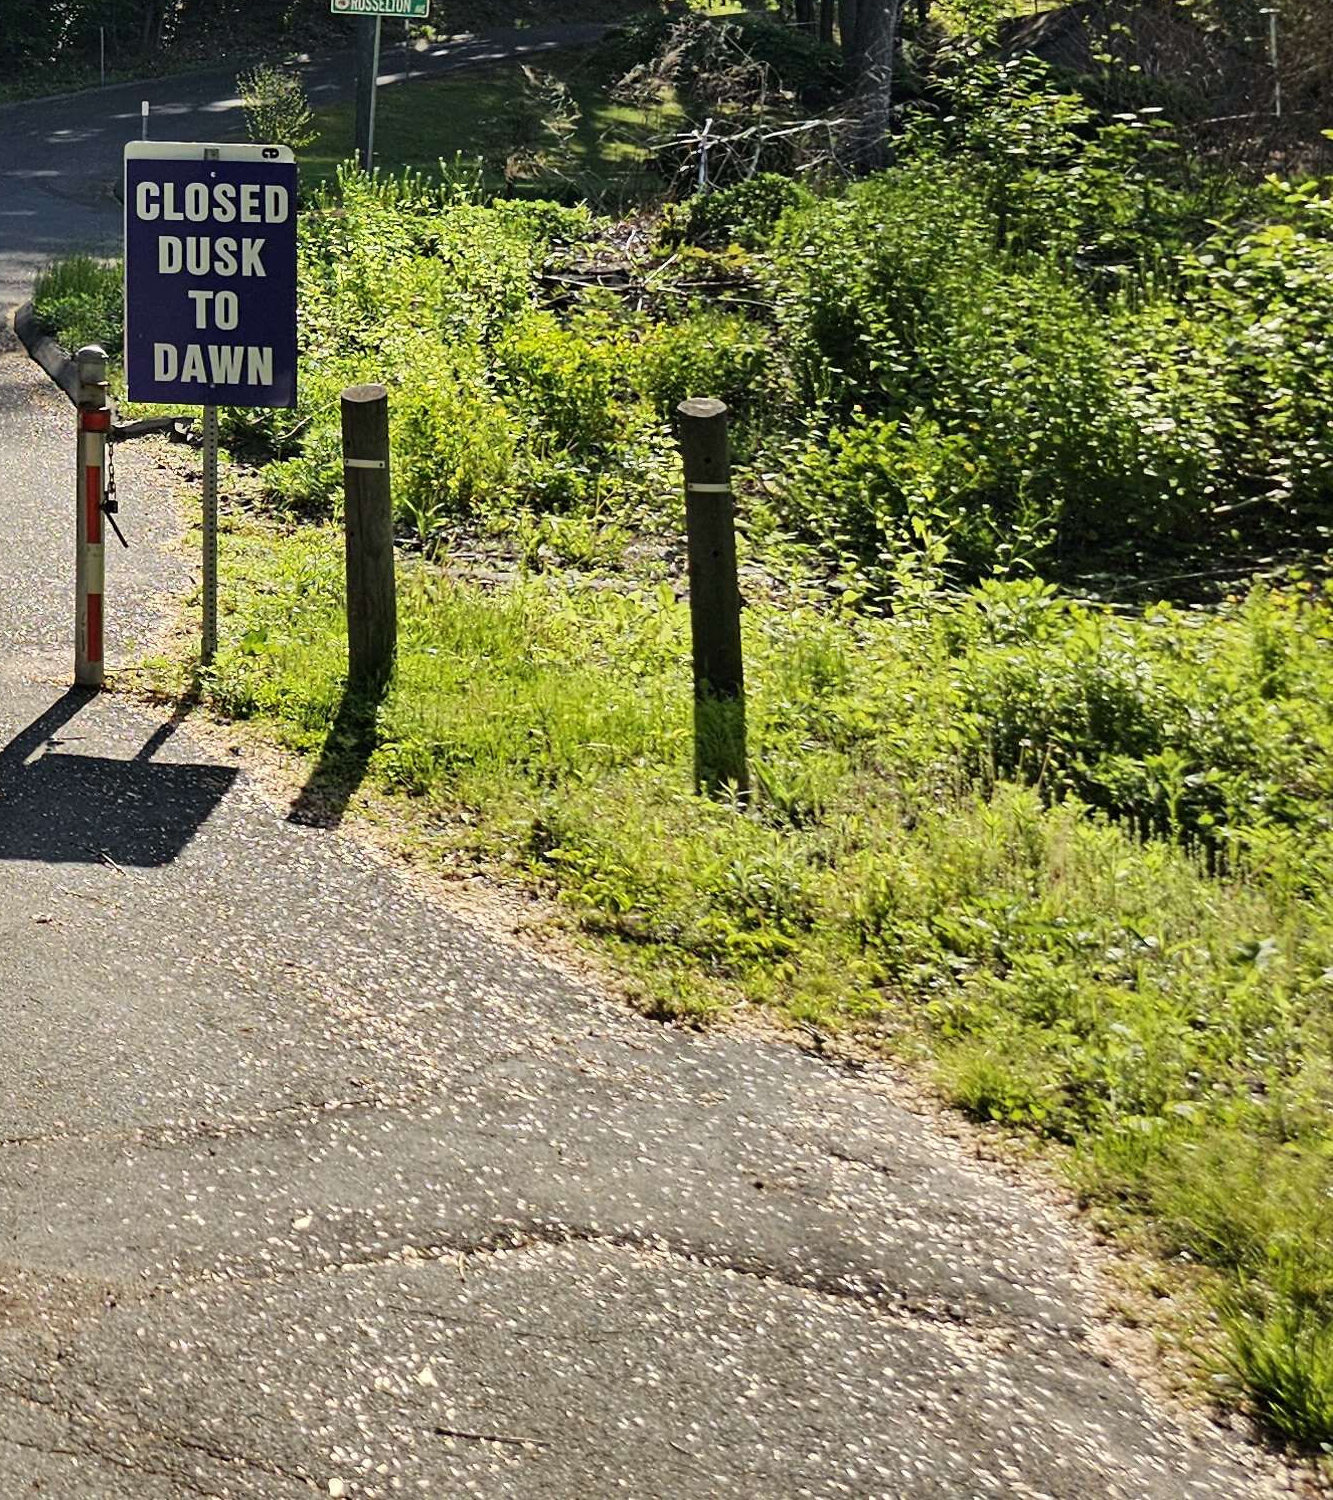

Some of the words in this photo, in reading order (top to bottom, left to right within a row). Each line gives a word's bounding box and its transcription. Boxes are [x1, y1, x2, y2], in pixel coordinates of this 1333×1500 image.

[136, 181, 289, 224] CLOSED
[158, 235, 266, 277] DUSK
[188, 290, 239, 331] TO
[154, 342, 273, 386] DAWN
